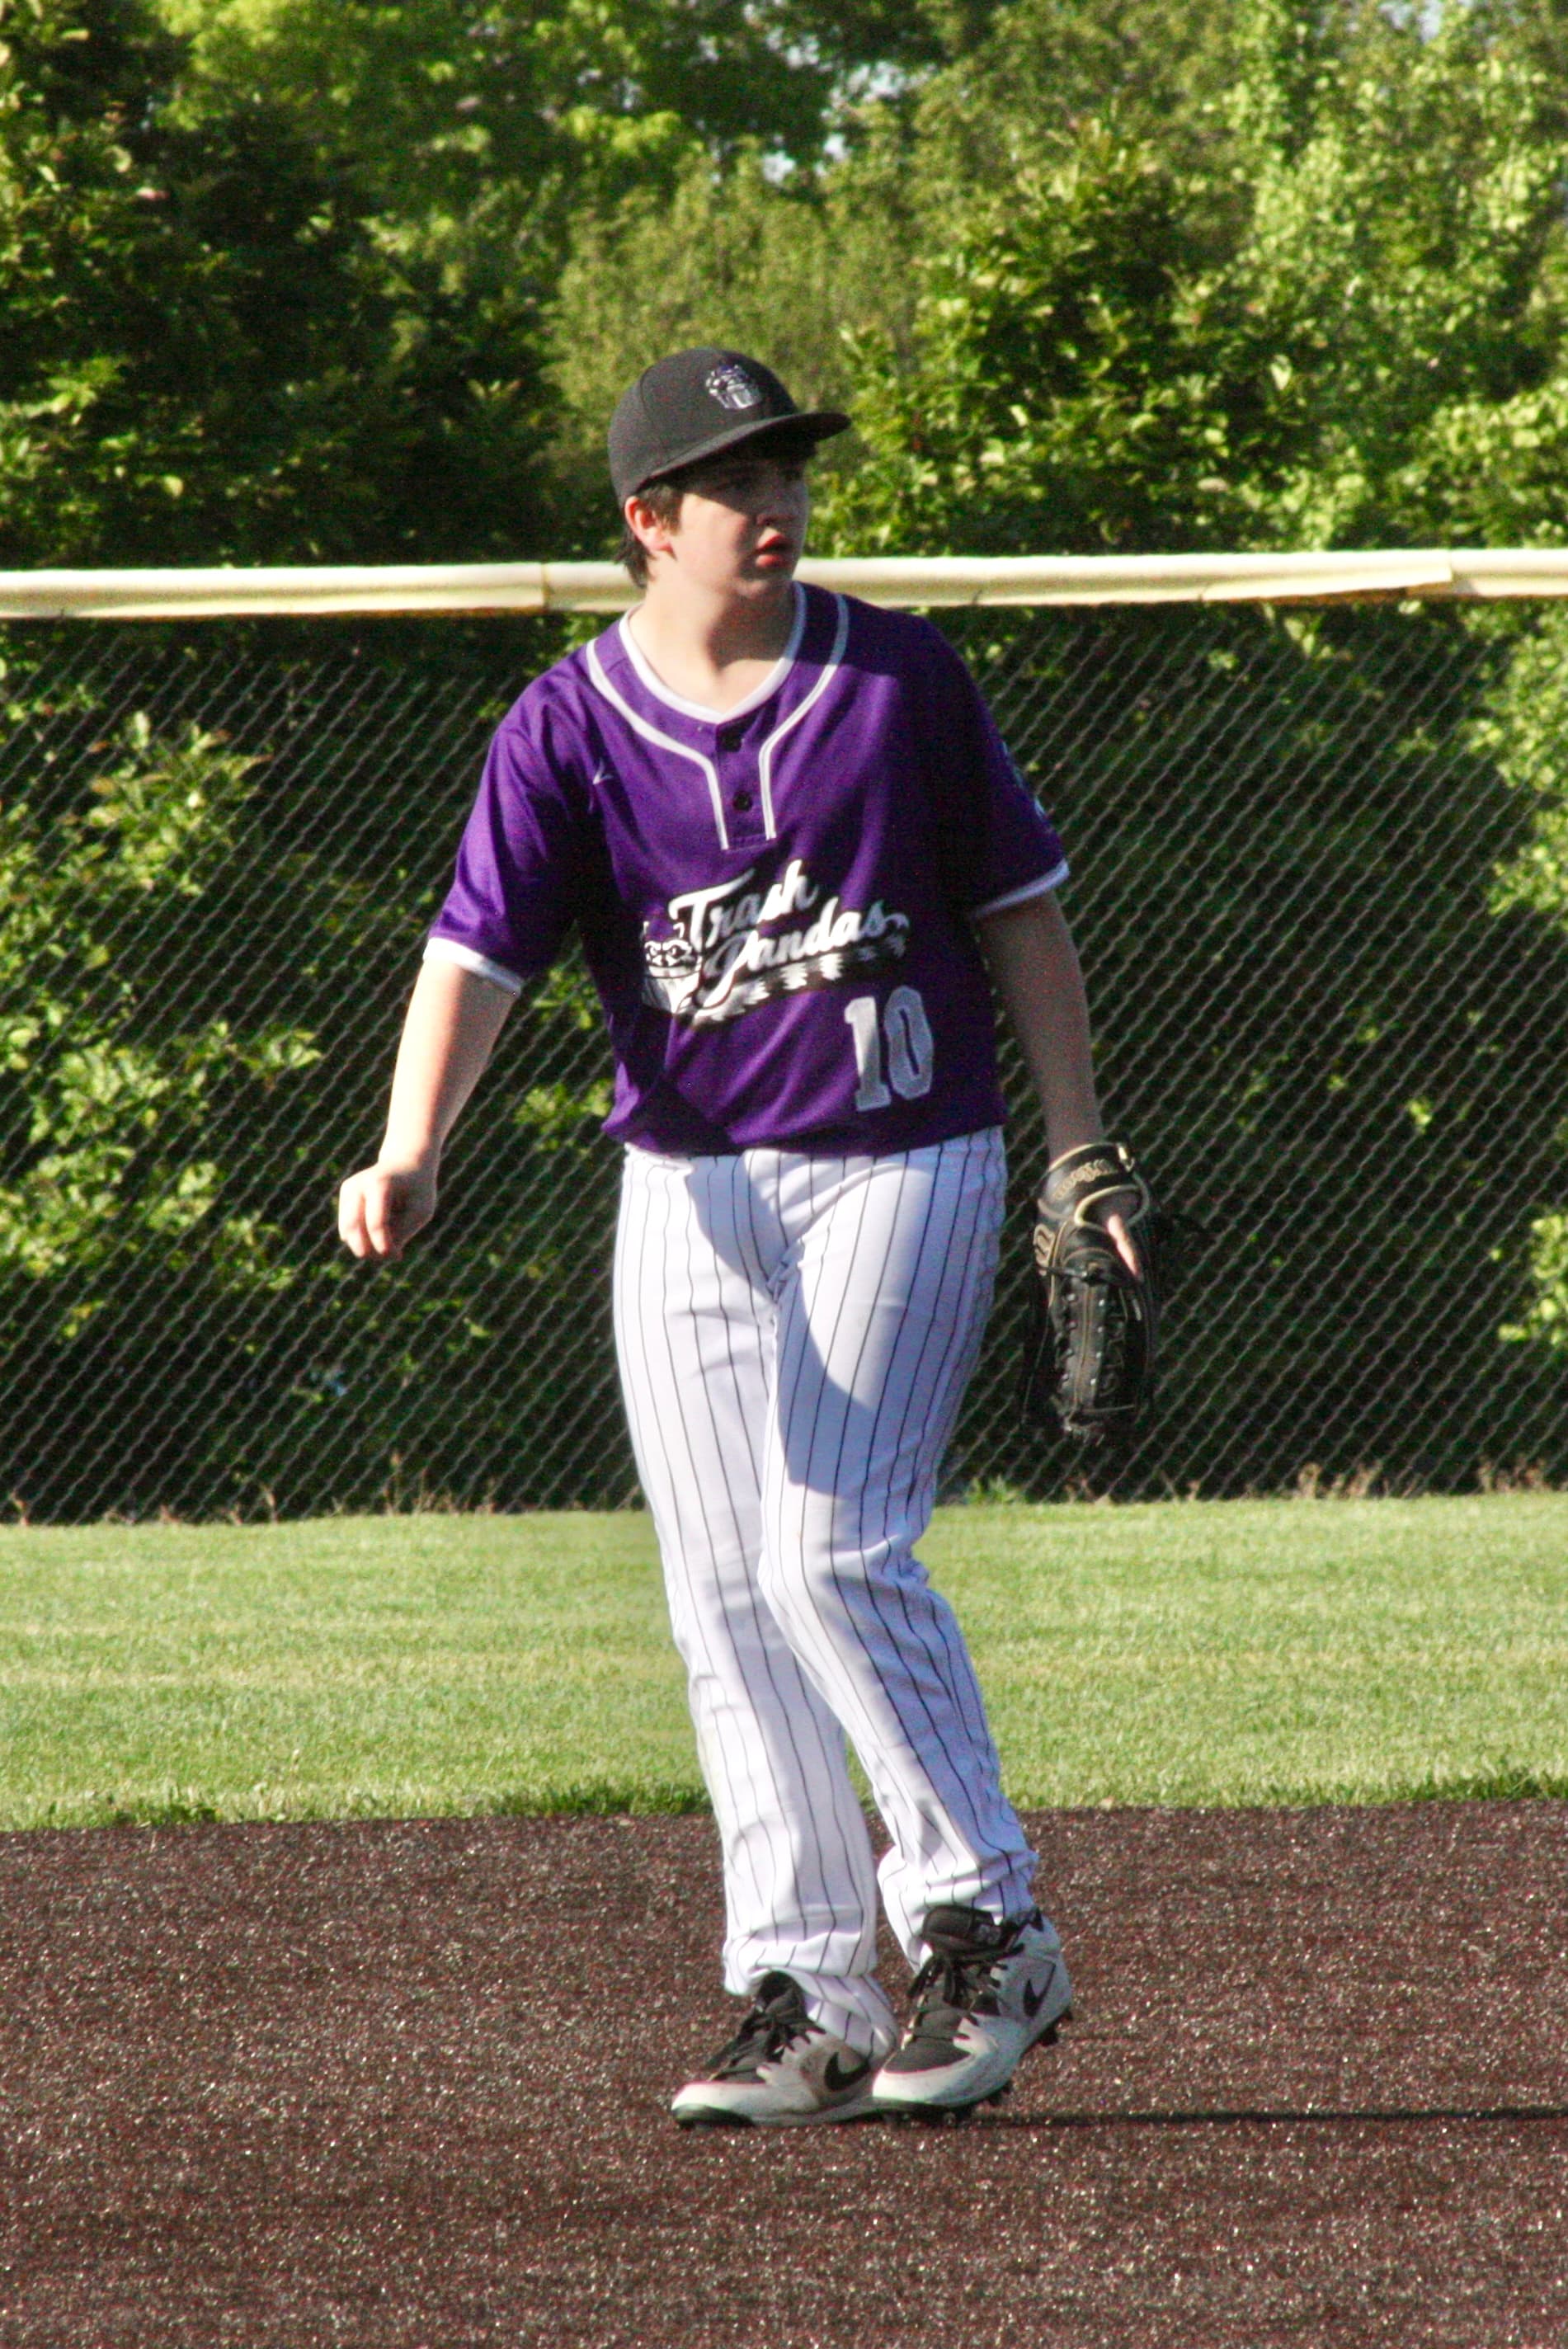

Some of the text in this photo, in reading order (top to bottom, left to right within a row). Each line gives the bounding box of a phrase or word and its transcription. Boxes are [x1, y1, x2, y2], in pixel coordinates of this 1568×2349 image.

[668, 859, 819, 953] Trash
[695, 898, 910, 1009] Pandas
[845, 986, 934, 1112] 10
